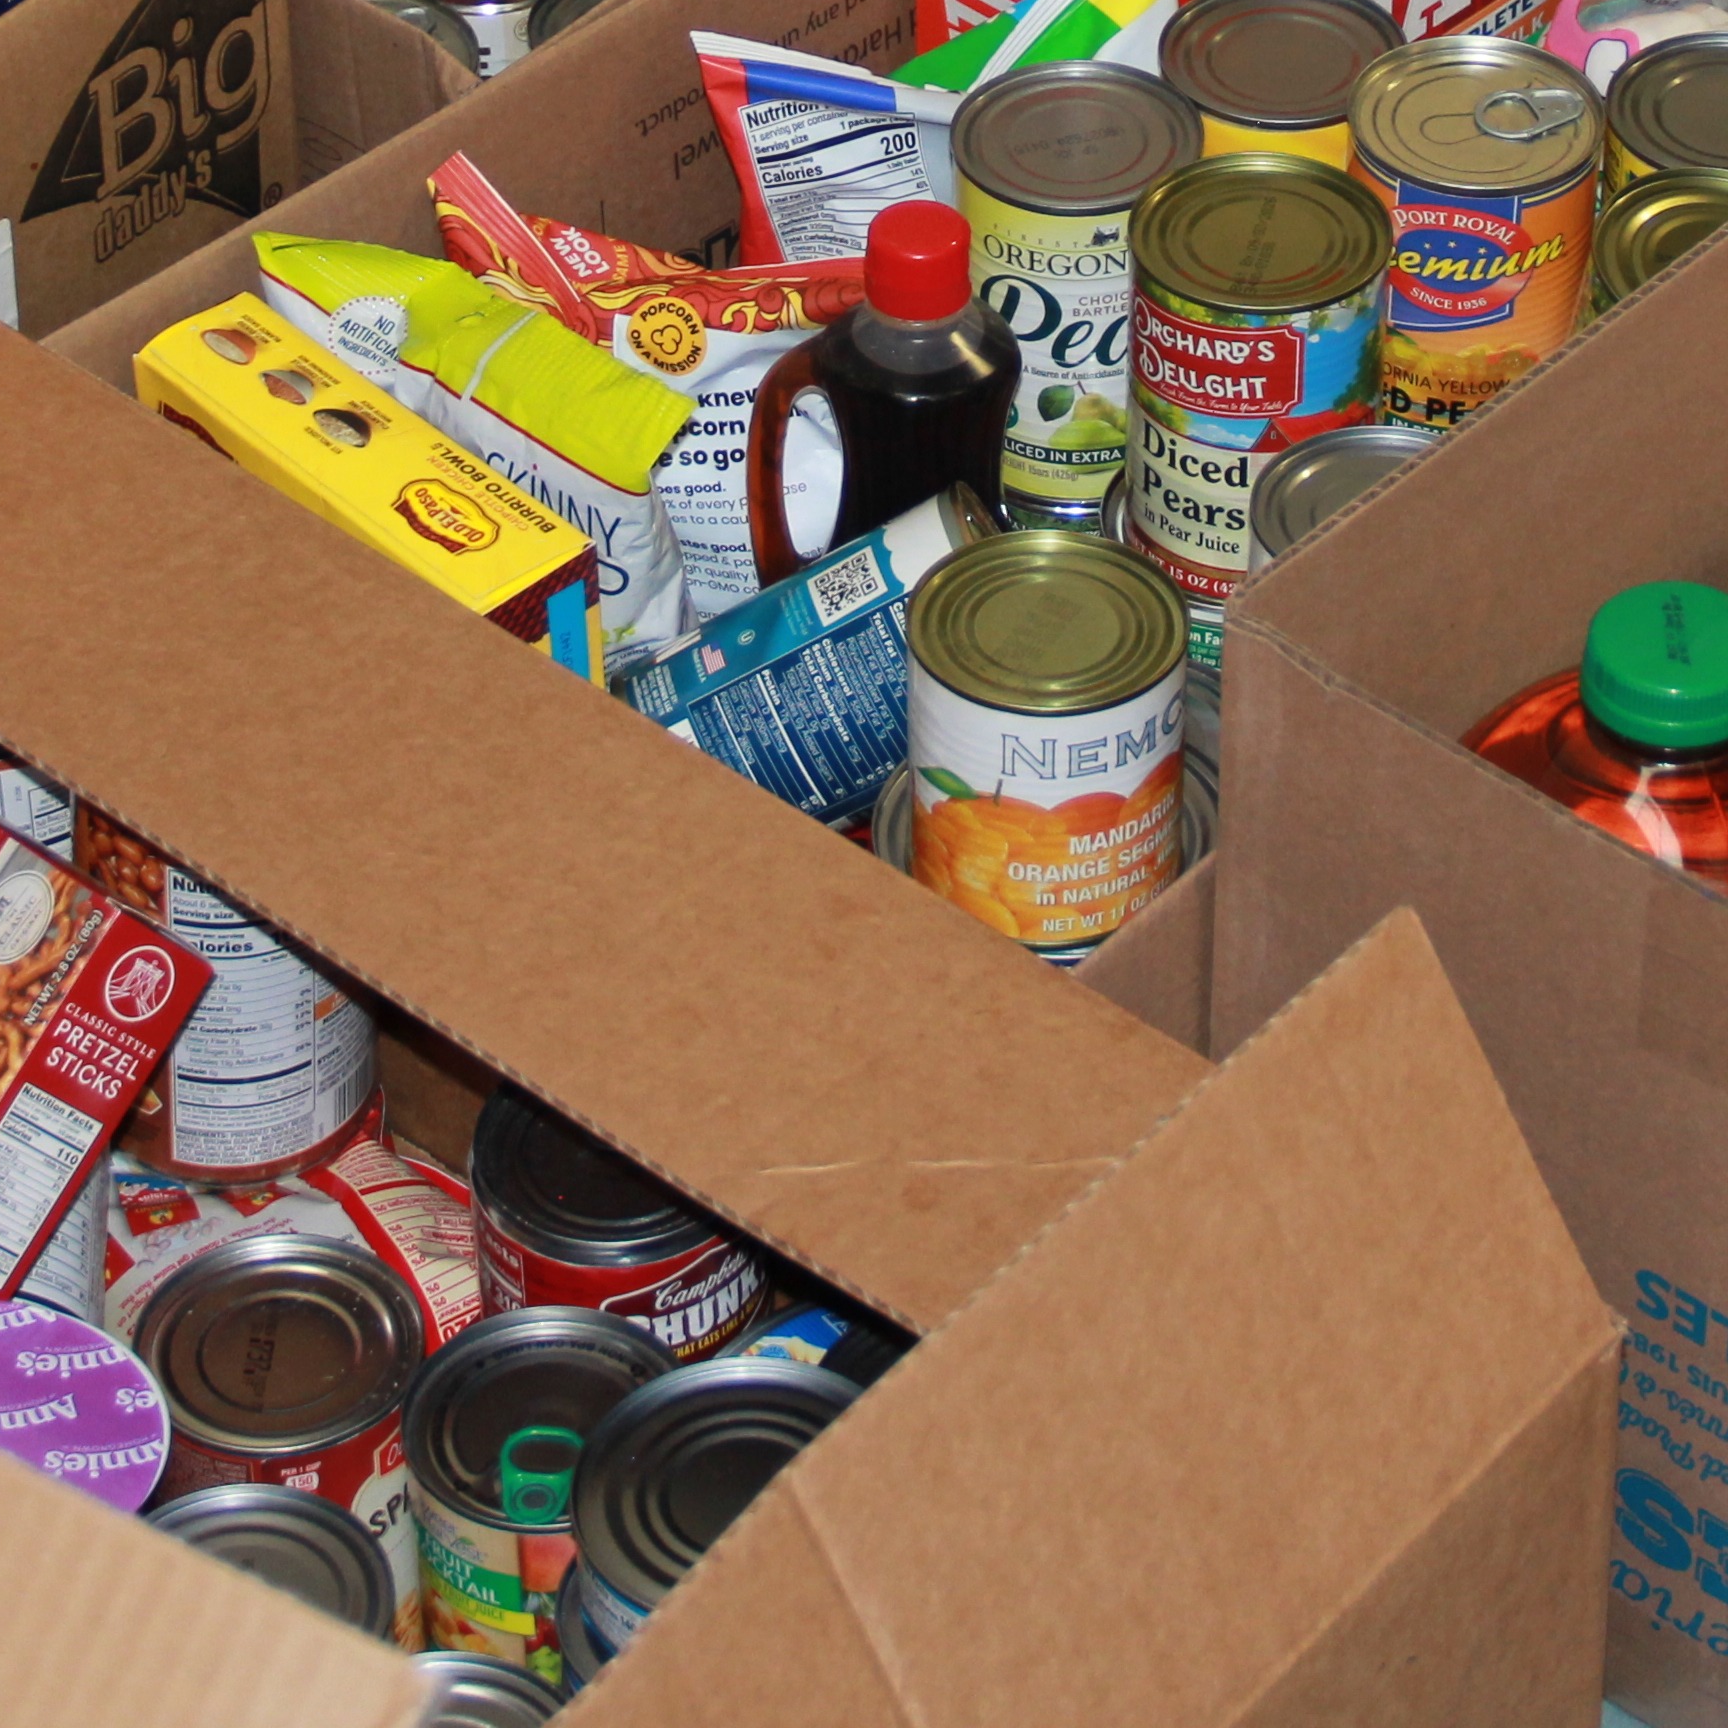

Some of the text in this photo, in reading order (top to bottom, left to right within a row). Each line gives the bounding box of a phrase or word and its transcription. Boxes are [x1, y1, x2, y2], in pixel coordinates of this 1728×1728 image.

[745, 101, 821, 128] Nutrition
[879, 130, 916, 156] 200
[761, 163, 823, 184] Calories
[93, 149, 214, 263] daddy's
[1392, 206, 1516, 246] PORT ROYAL
[553, 236, 592, 279] NEW
[562, 225, 611, 276] LOOK
[983, 232, 1129, 278] OREGON
[1388, 229, 1564, 284] emium
[640, 302, 701, 337] POPCORN
[1409, 285, 1487, 312] SINCE 1936
[337, 317, 400, 363] ARTIFICIAL
[372, 313, 398, 336] NO
[1134, 298, 1276, 367] ORCHARD'S
[339, 336, 388, 368] INGREDIENTS
[1138, 350, 1269, 402] DELIGHT
[678, 449, 709, 465] so
[1069, 446, 1125, 464] EXTRA
[1140, 419, 1251, 491] Diced
[484, 481, 557, 535] BURRITO
[683, 481, 727, 496] good.
[694, 497, 736, 514] every
[1142, 471, 1247, 534] Pears
[1143, 503, 1241, 556] in Pear Juice
[812, 673, 852, 743] Carbohydrate
[1007, 856, 1113, 884] ORANGE
[1061, 865, 1150, 906] NATURAL
[52, 1017, 139, 1081] PRETZEL
[46, 1046, 123, 1100] STICKS
